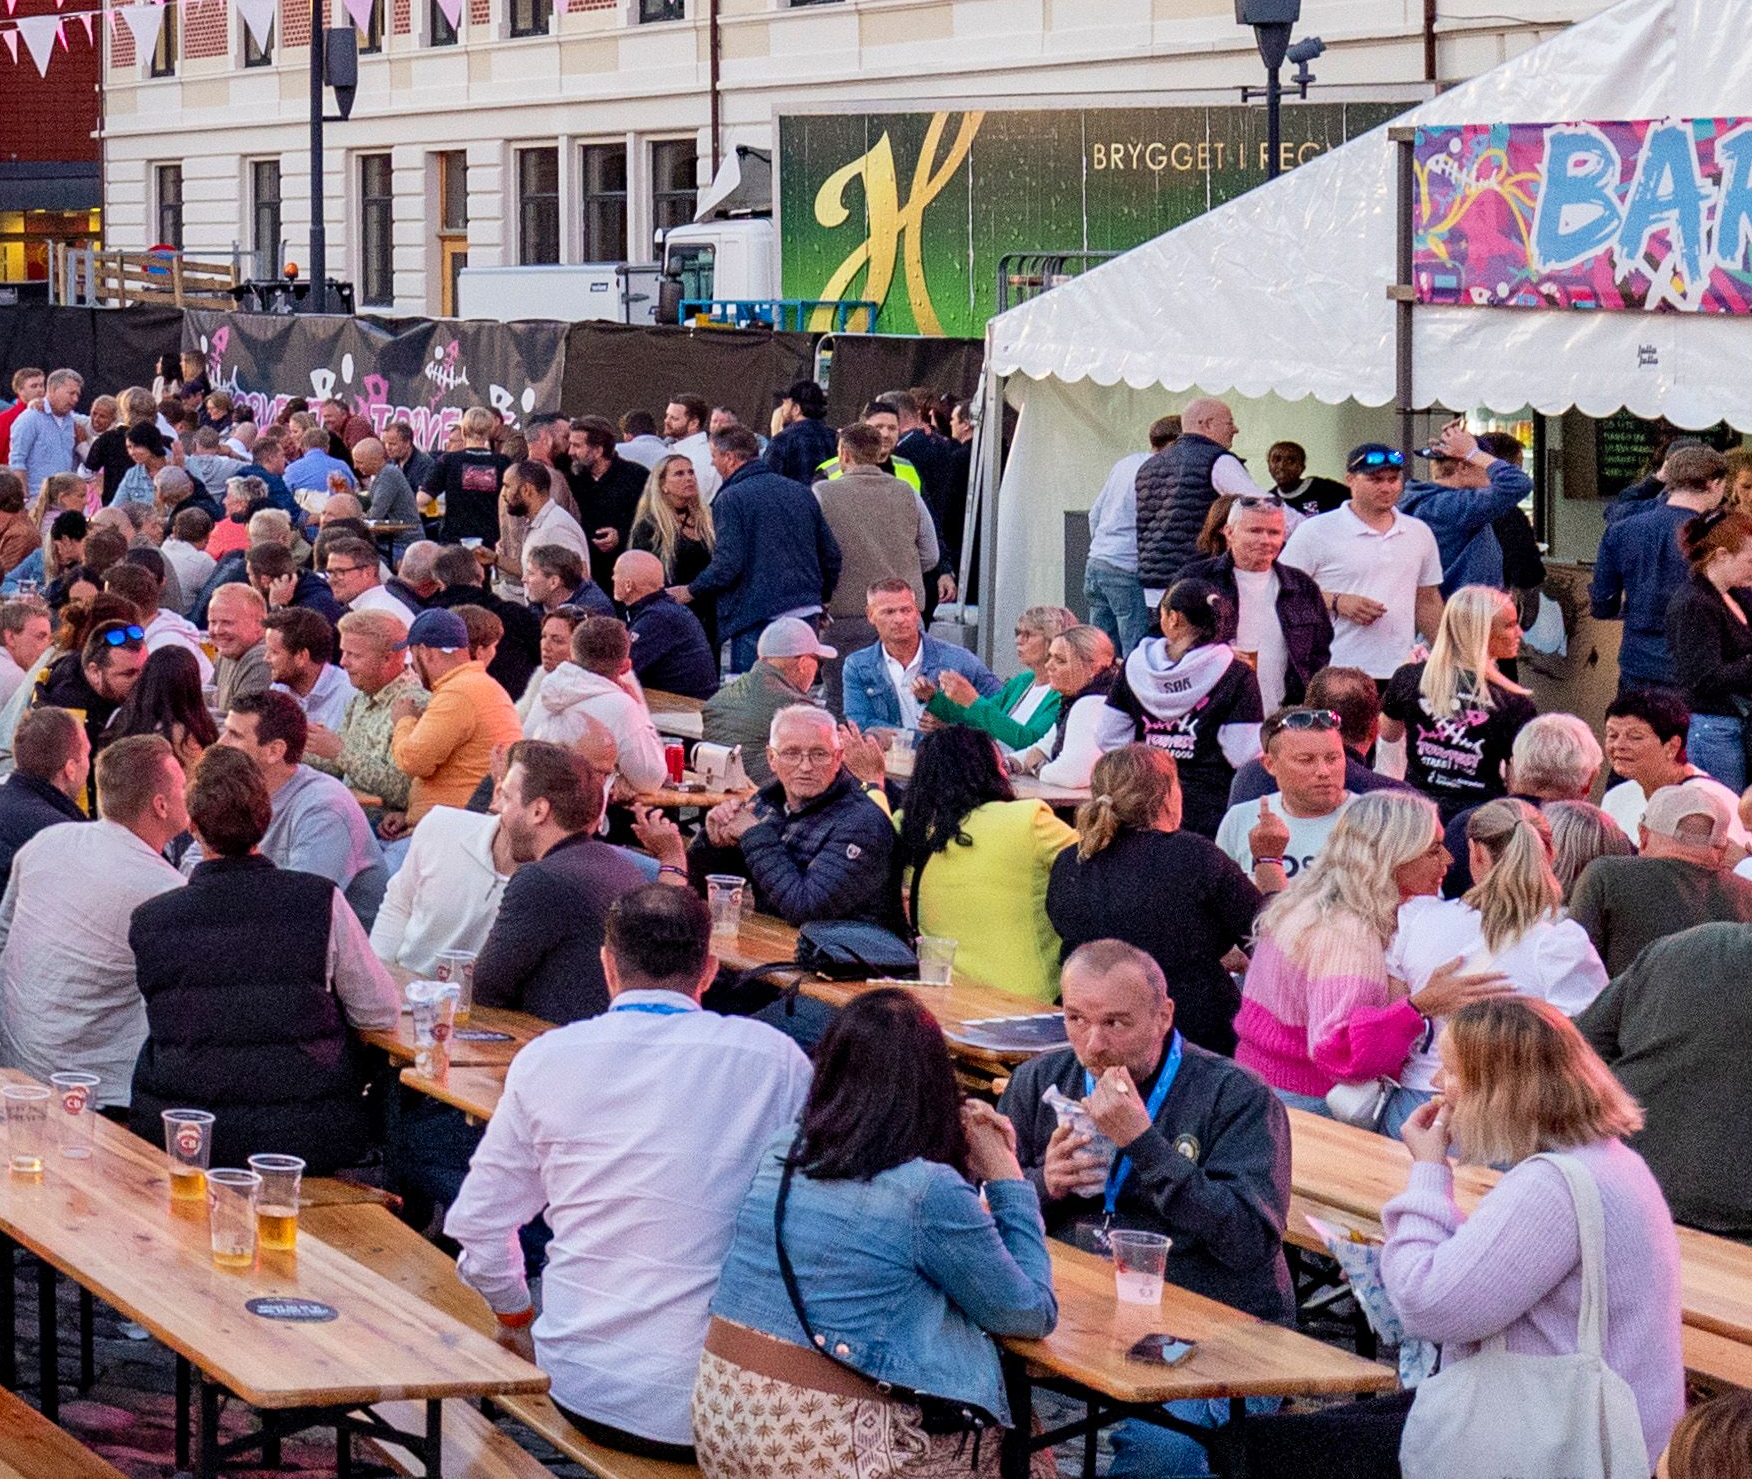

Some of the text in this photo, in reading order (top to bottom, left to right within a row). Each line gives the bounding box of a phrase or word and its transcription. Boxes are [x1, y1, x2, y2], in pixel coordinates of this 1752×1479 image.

[1093, 142, 1333, 170] BRYGGET I REG
